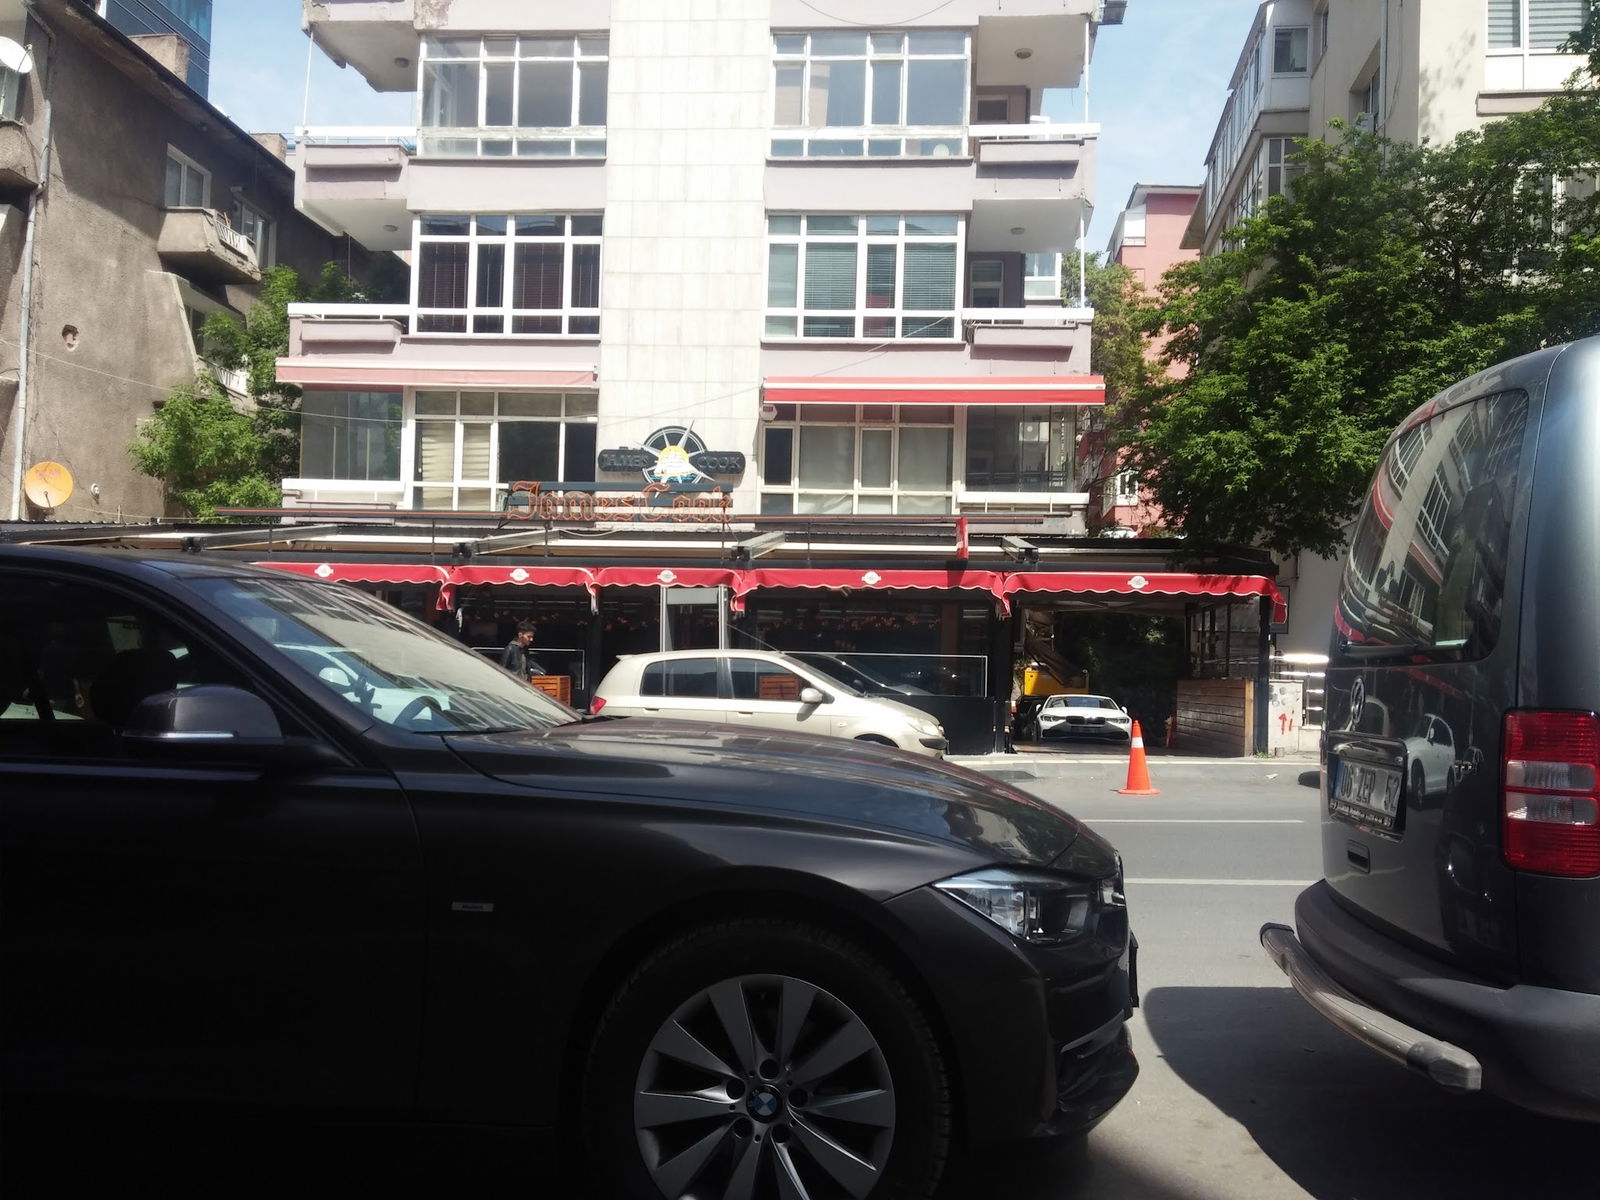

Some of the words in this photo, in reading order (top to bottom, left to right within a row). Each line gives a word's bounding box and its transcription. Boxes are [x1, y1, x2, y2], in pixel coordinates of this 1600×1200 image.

[697, 455, 741, 469] COOK
[507, 480, 635, 520] James
[640, 482, 734, 523] Cook
